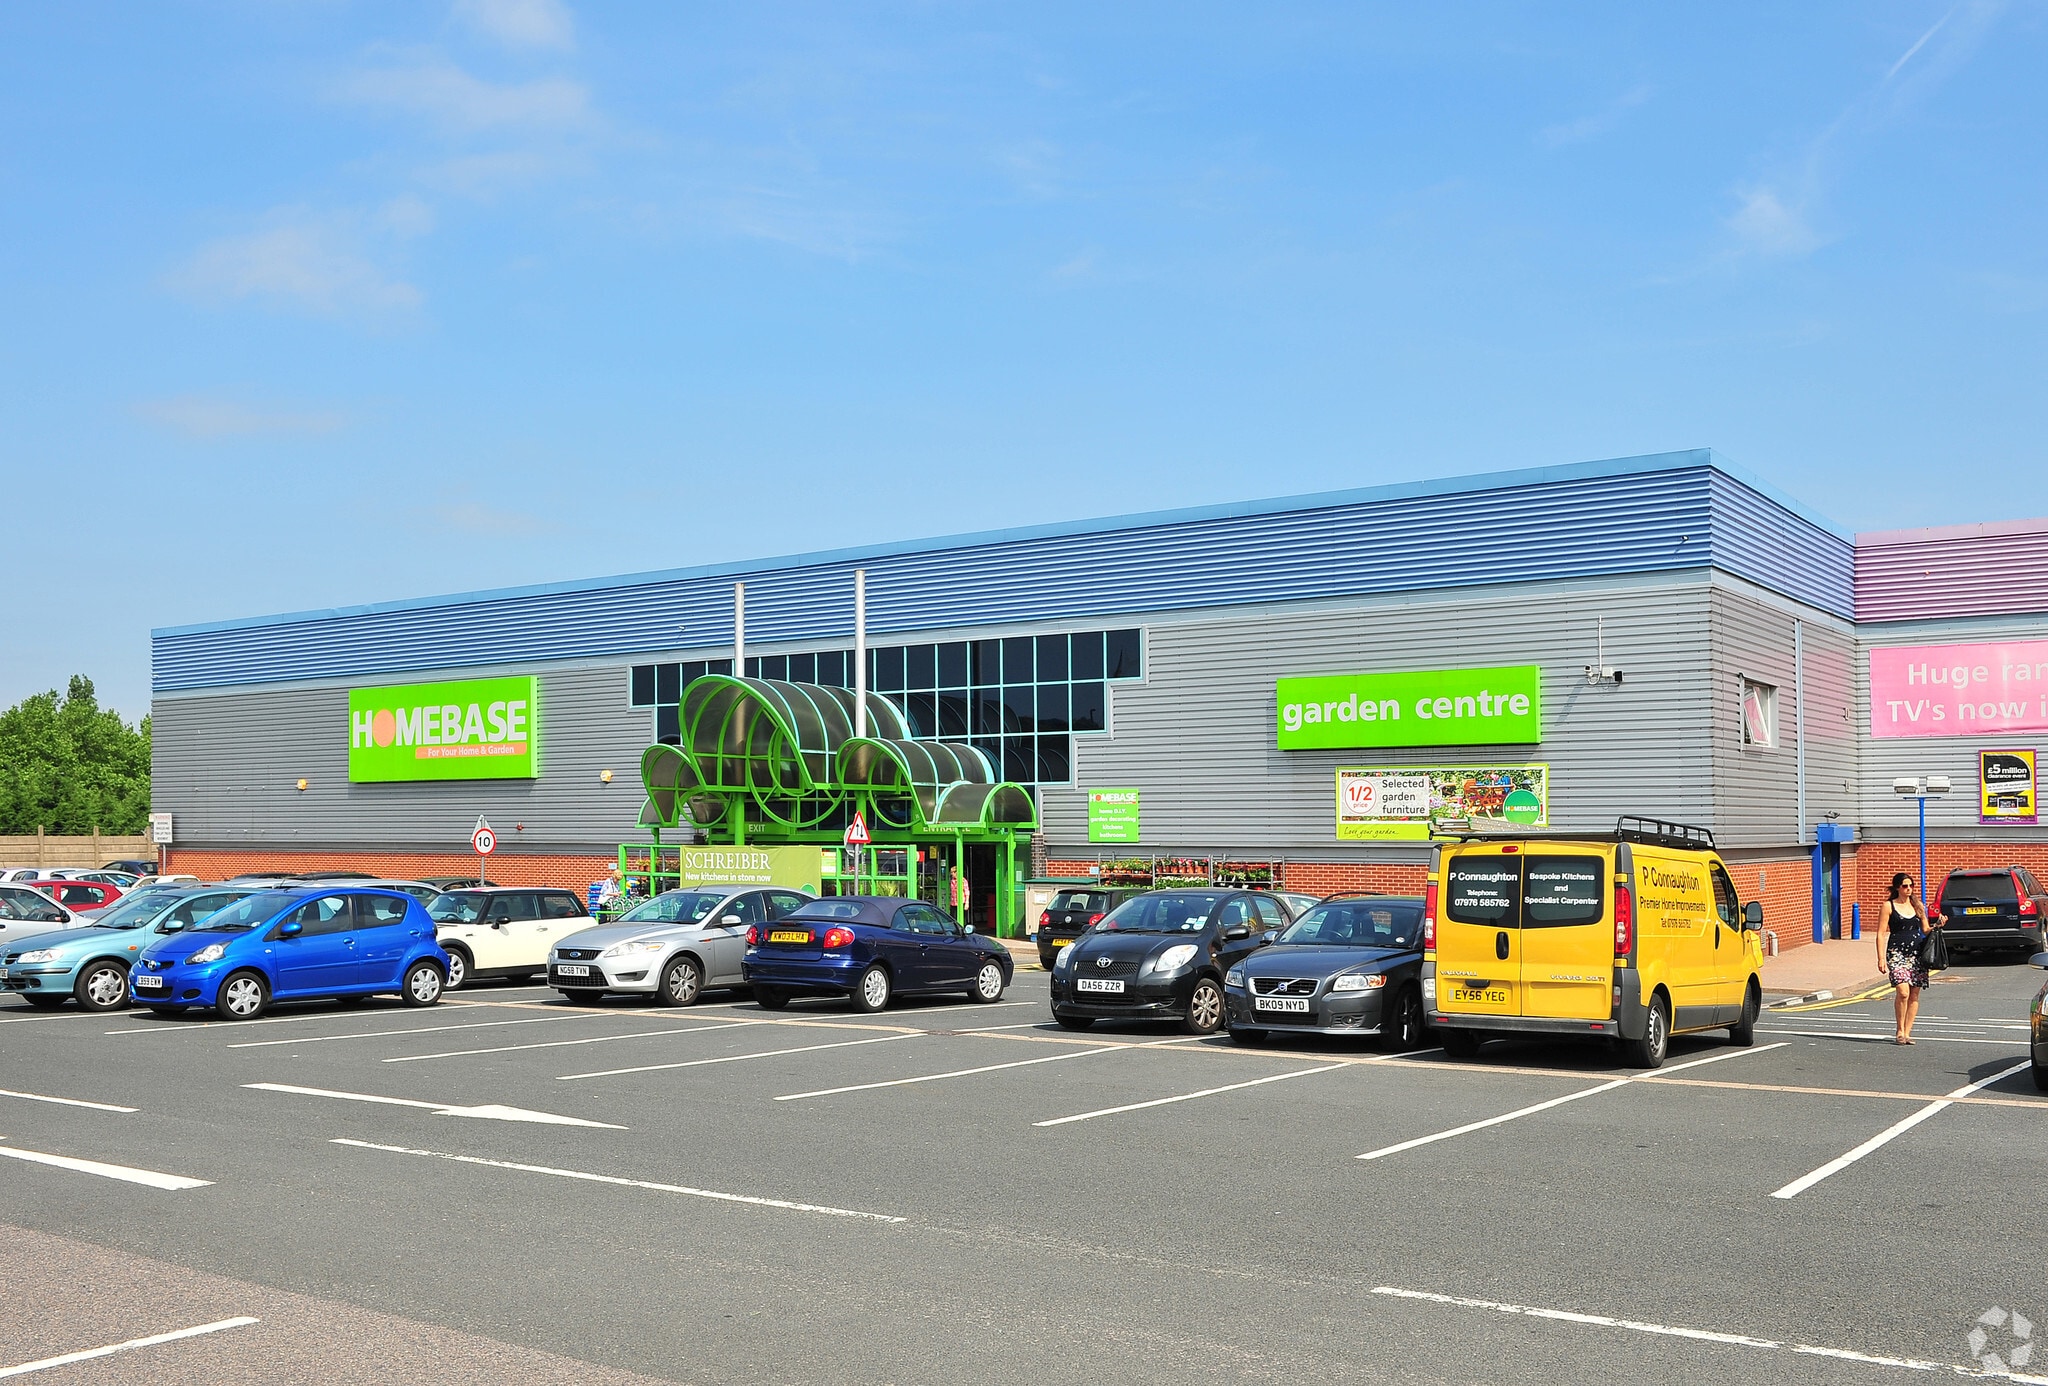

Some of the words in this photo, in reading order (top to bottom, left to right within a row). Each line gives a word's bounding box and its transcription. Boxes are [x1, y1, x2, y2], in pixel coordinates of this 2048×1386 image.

[1908, 662, 1989, 689] Huge
[1283, 693, 1400, 732] garden
[1415, 689, 1530, 720] centre
[1886, 700, 1946, 722] TV's
[1958, 701, 2028, 720] now
[353, 700, 527, 748] HOMEBASE
[428, 748, 440, 757] For
[441, 747, 457, 756] Your
[459, 746, 479, 755] Home
[481, 746, 486, 754] &
[488, 744, 515, 754] Garden
[1988, 764, 2001, 774] £5
[1382, 779, 1425, 788] Selected
[1090, 793, 1136, 802] HOMEBASE
[1349, 786, 1373, 801] 1/2
[1382, 792, 1416, 803] garden
[1382, 805, 1426, 814] furniture
[748, 824, 766, 832] EXIT
[478, 836, 491, 847] 10
[685, 852, 771, 870] SCHREIBER
[685, 871, 700, 880] New
[701, 872, 729, 881] kitchens
[730, 873, 737, 881] in
[738, 873, 756, 882] store
[757, 874, 772, 882] now
[1450, 872, 1457, 881] P
[1458, 872, 1518, 883] Connaughton
[1529, 872, 1561, 881] Bespoke
[1561, 872, 1595, 881] Kitchens
[1642, 866, 1649, 886] P
[1651, 867, 1700, 893] Connaughton
[1467, 889, 1498, 897] Telephone:
[1454, 898, 1478, 907] 07976
[1524, 896, 1560, 905] Specialist
[1561, 896, 1599, 906] Carpenter
[1640, 896, 1661, 909] Premier
[1661, 898, 1675, 910] Home
[1675, 899, 1706, 913] Improvements
[1081, 980, 1103, 990] DA56
[1105, 981, 1121, 991] ZZR
[1455, 990, 1482, 1001] EY56
[1485, 991, 1505, 1002] YEG
[1260, 999, 1284, 1010] BK09
[1286, 1000, 1305, 1011] NYD
